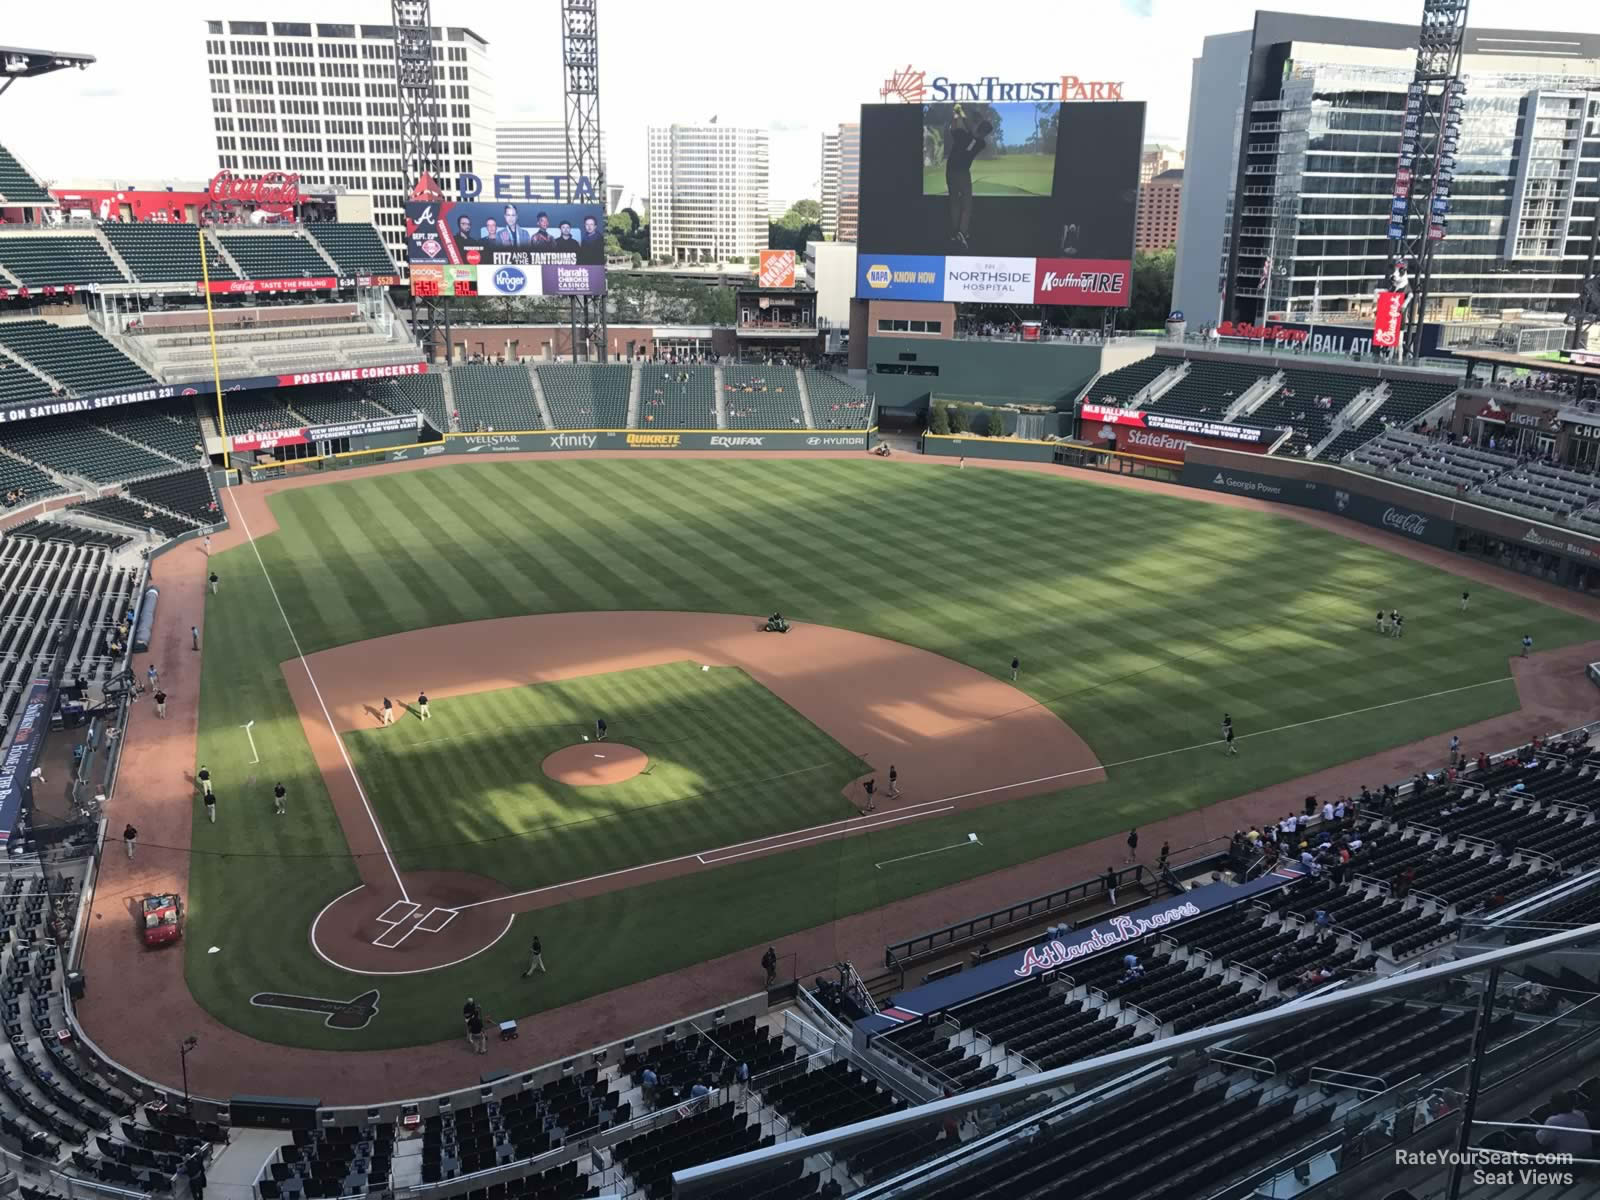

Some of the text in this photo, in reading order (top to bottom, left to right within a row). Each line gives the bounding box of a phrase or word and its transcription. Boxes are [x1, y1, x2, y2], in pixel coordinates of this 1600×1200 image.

[459, 173, 596, 200] DELTA
[493, 252, 512, 264] FITZ
[530, 252, 576, 265] TANTRUMS
[760, 250, 793, 286] HOME
[298, 280, 326, 288] FEELING
[340, 278, 355, 286] 6:34
[495, 270, 524, 291] Kroger
[871, 271, 936, 284] NAPA KNOW HOW
[949, 271, 1031, 283] NORTHSIDE
[1080, 272, 1124, 293] TIRE
[88, 283, 100, 294] 42
[416, 281, 437, 290] 250
[456, 281, 469, 290] 50
[963, 284, 1015, 292] HOSPITAL
[1313, 334, 1346, 354] BALL
[294, 364, 420, 385] POSTGAME CONCERTS
[10, 410, 26, 421] ON
[30, 399, 92, 416] SATURDAY,
[94, 391, 156, 408] SEPTEMBER
[159, 388, 174, 398] 23!
[1083, 404, 1140, 418] MLB BALLPARK
[328, 424, 366, 434] HIGHLIGHTS
[1148, 422, 1186, 432] EXPERIENCE
[1201, 428, 1220, 436] FROM
[1240, 433, 1258, 441] SEAT!
[1165, 418, 1203, 428] HIGHLIGHTS
[1210, 424, 1242, 433] ENHANCE
[1243, 428, 1261, 436] YOUR
[235, 430, 300, 444] MLB BALLPARK
[312, 431, 350, 440] EXPERIENCE
[465, 435, 519, 445] WELLSTAR
[551, 433, 597, 449] xfinity
[626, 433, 680, 447] QUIKRETE
[710, 436, 764, 448] EQUIFAX
[823, 437, 864, 445] HYUNDAI
[260, 440, 278, 448] APP
[1226, 478, 1281, 494] Georgia Power
[1382, 507, 1428, 536] Coca-Cola
[6, 744, 29, 766] HOME
[1015, 902, 1200, 977] Atlanta Braves
